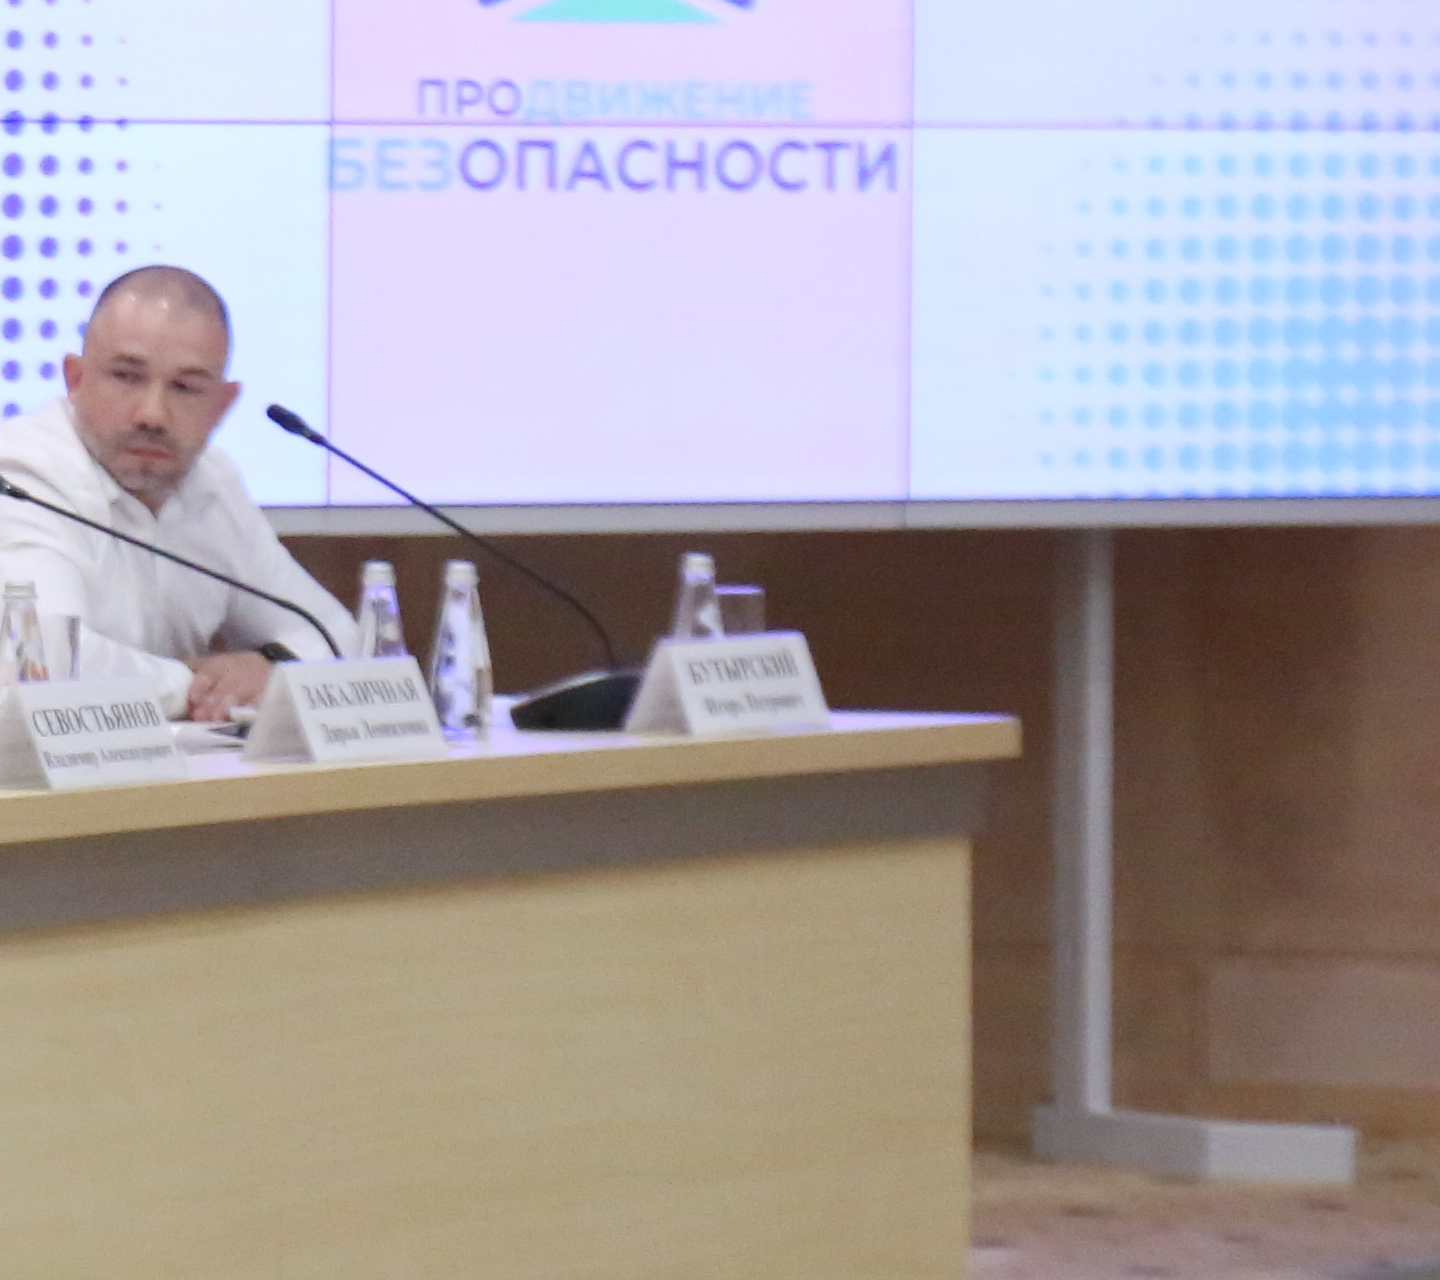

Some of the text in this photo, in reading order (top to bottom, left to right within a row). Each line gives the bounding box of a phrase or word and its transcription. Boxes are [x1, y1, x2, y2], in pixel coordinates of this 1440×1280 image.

[416, 77, 814, 125] ПРОДВИЖЕНИЕ
[325, 138, 898, 192] БЕЗОПАСНОСТИ
[32, 701, 161, 737] СЕВОСТЬЯНОВ
